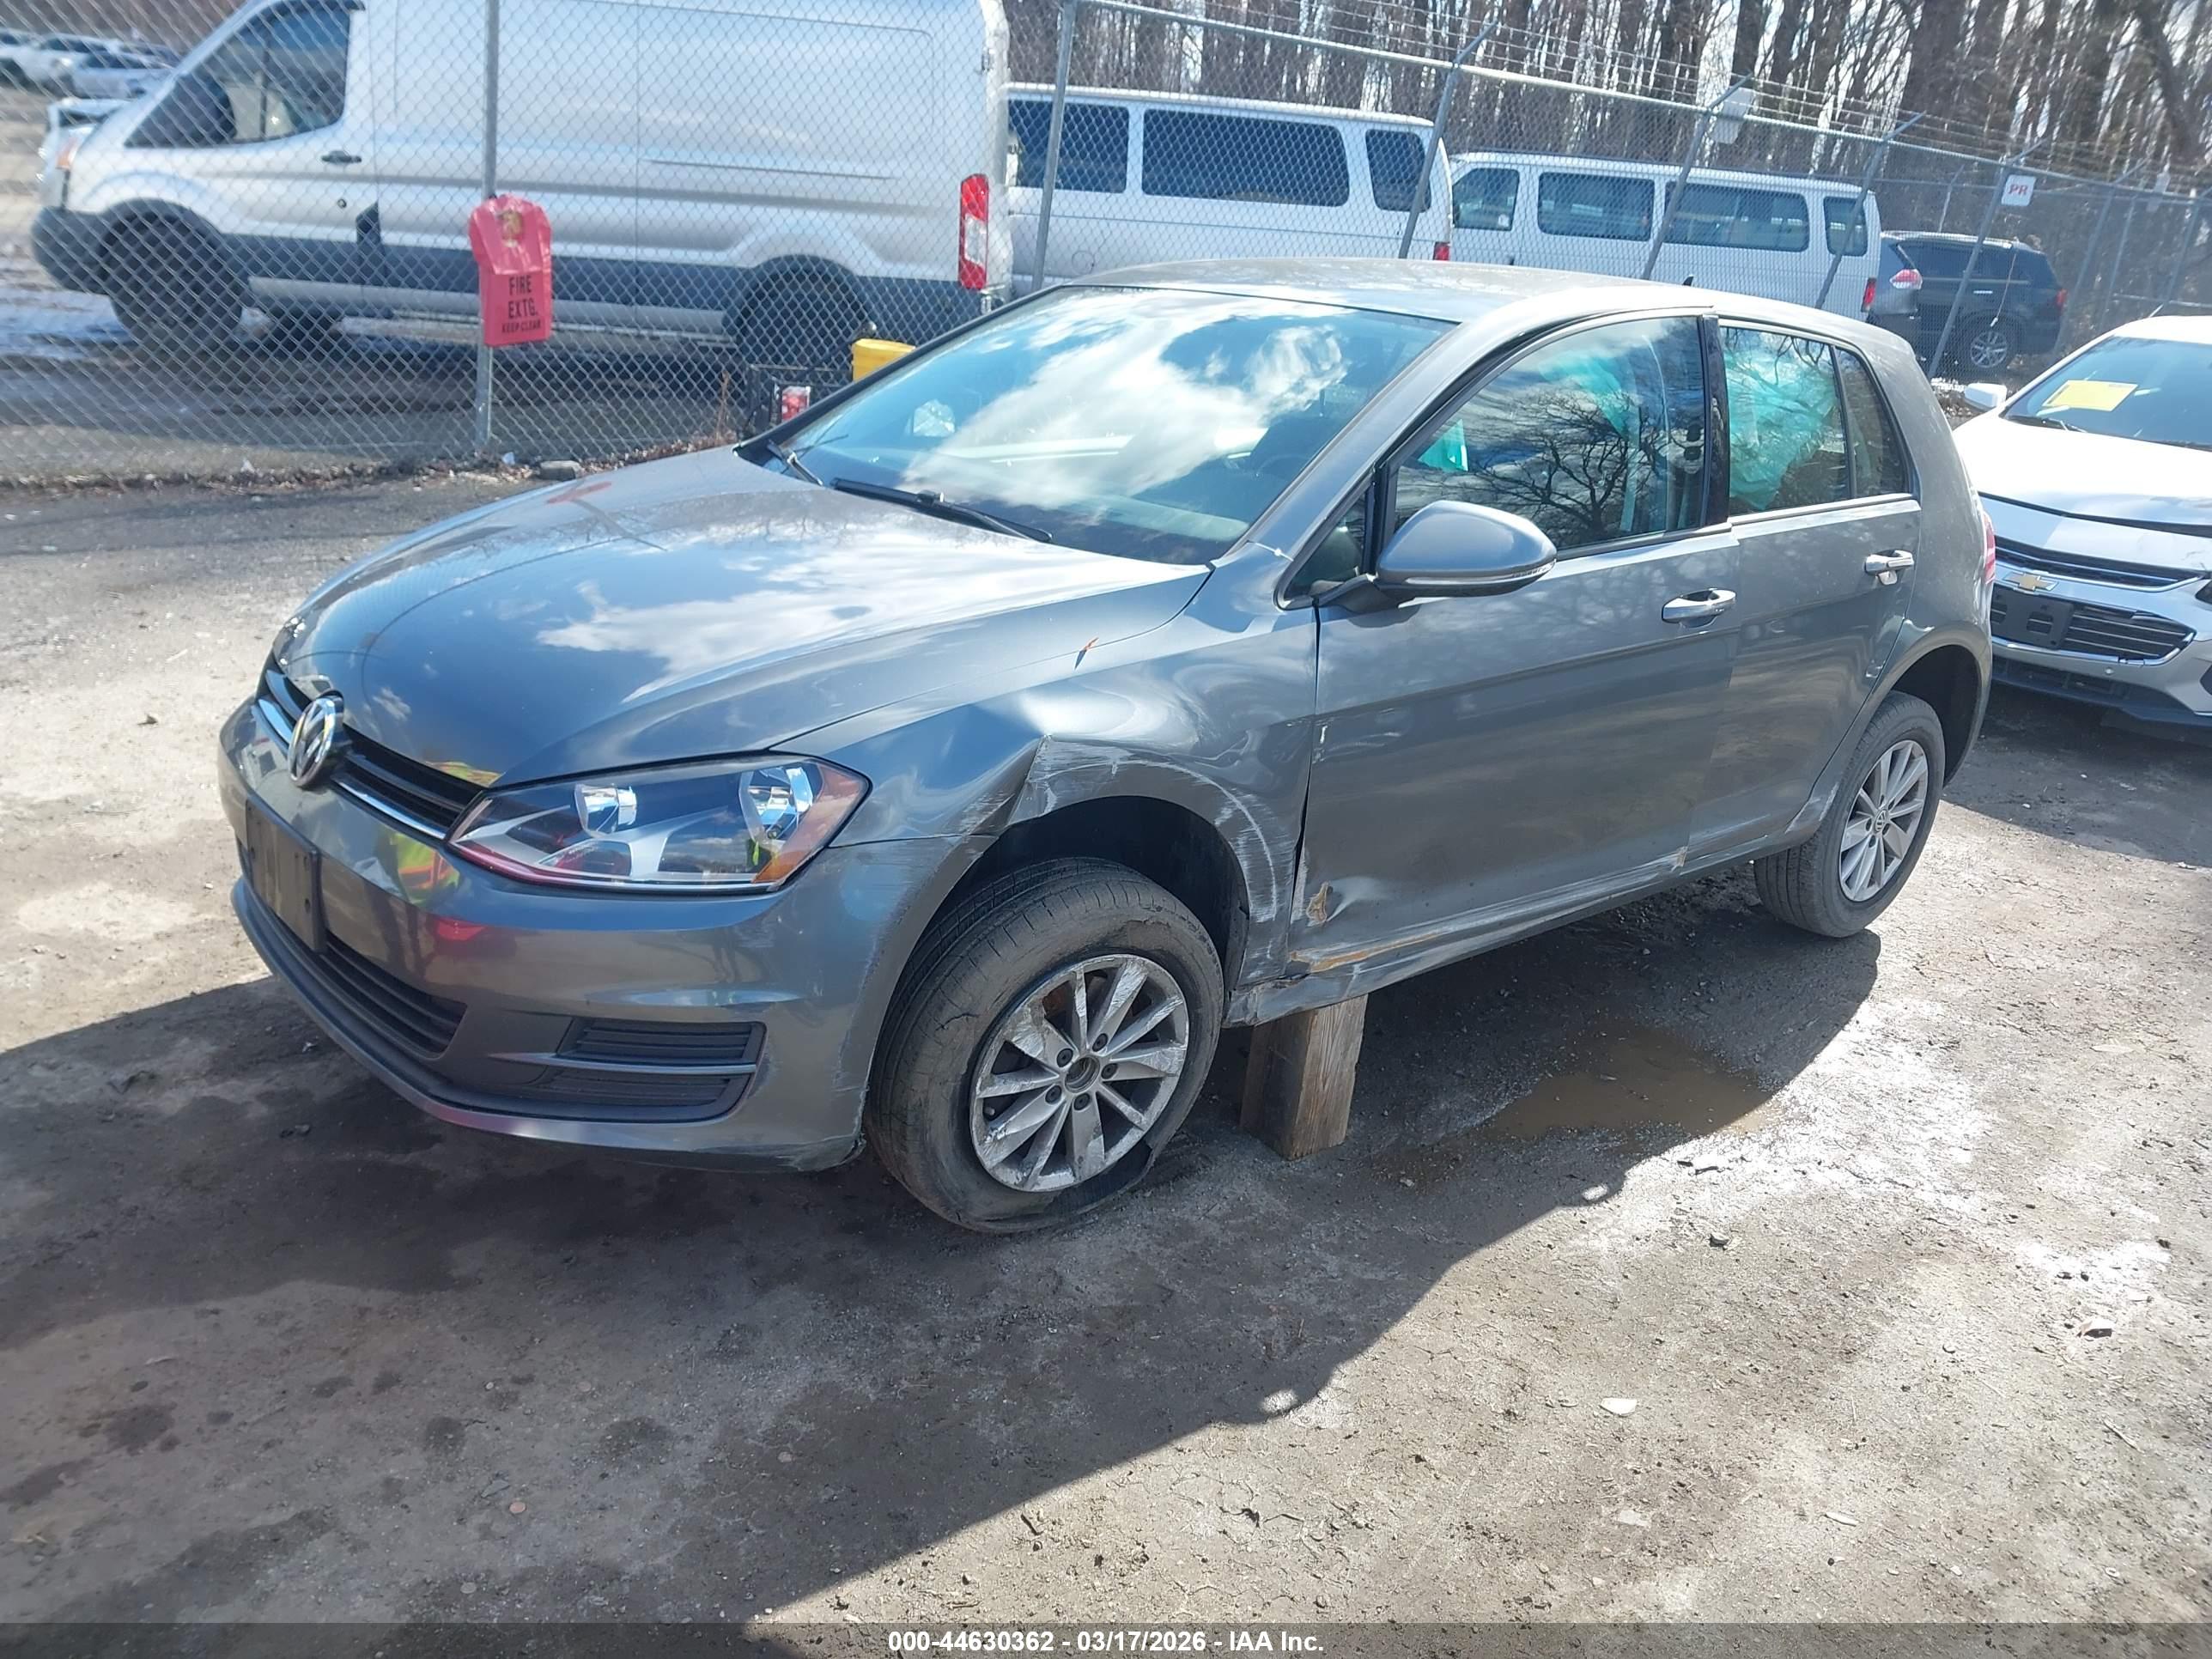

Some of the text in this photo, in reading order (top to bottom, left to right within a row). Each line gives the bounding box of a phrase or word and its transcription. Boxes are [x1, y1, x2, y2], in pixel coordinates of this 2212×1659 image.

[2008, 184, 2028, 195] PR
[508, 275, 532, 295] FIRE
[508, 297, 538, 319] EXTG.
[501, 319, 541, 333] KEEP CLEAR
